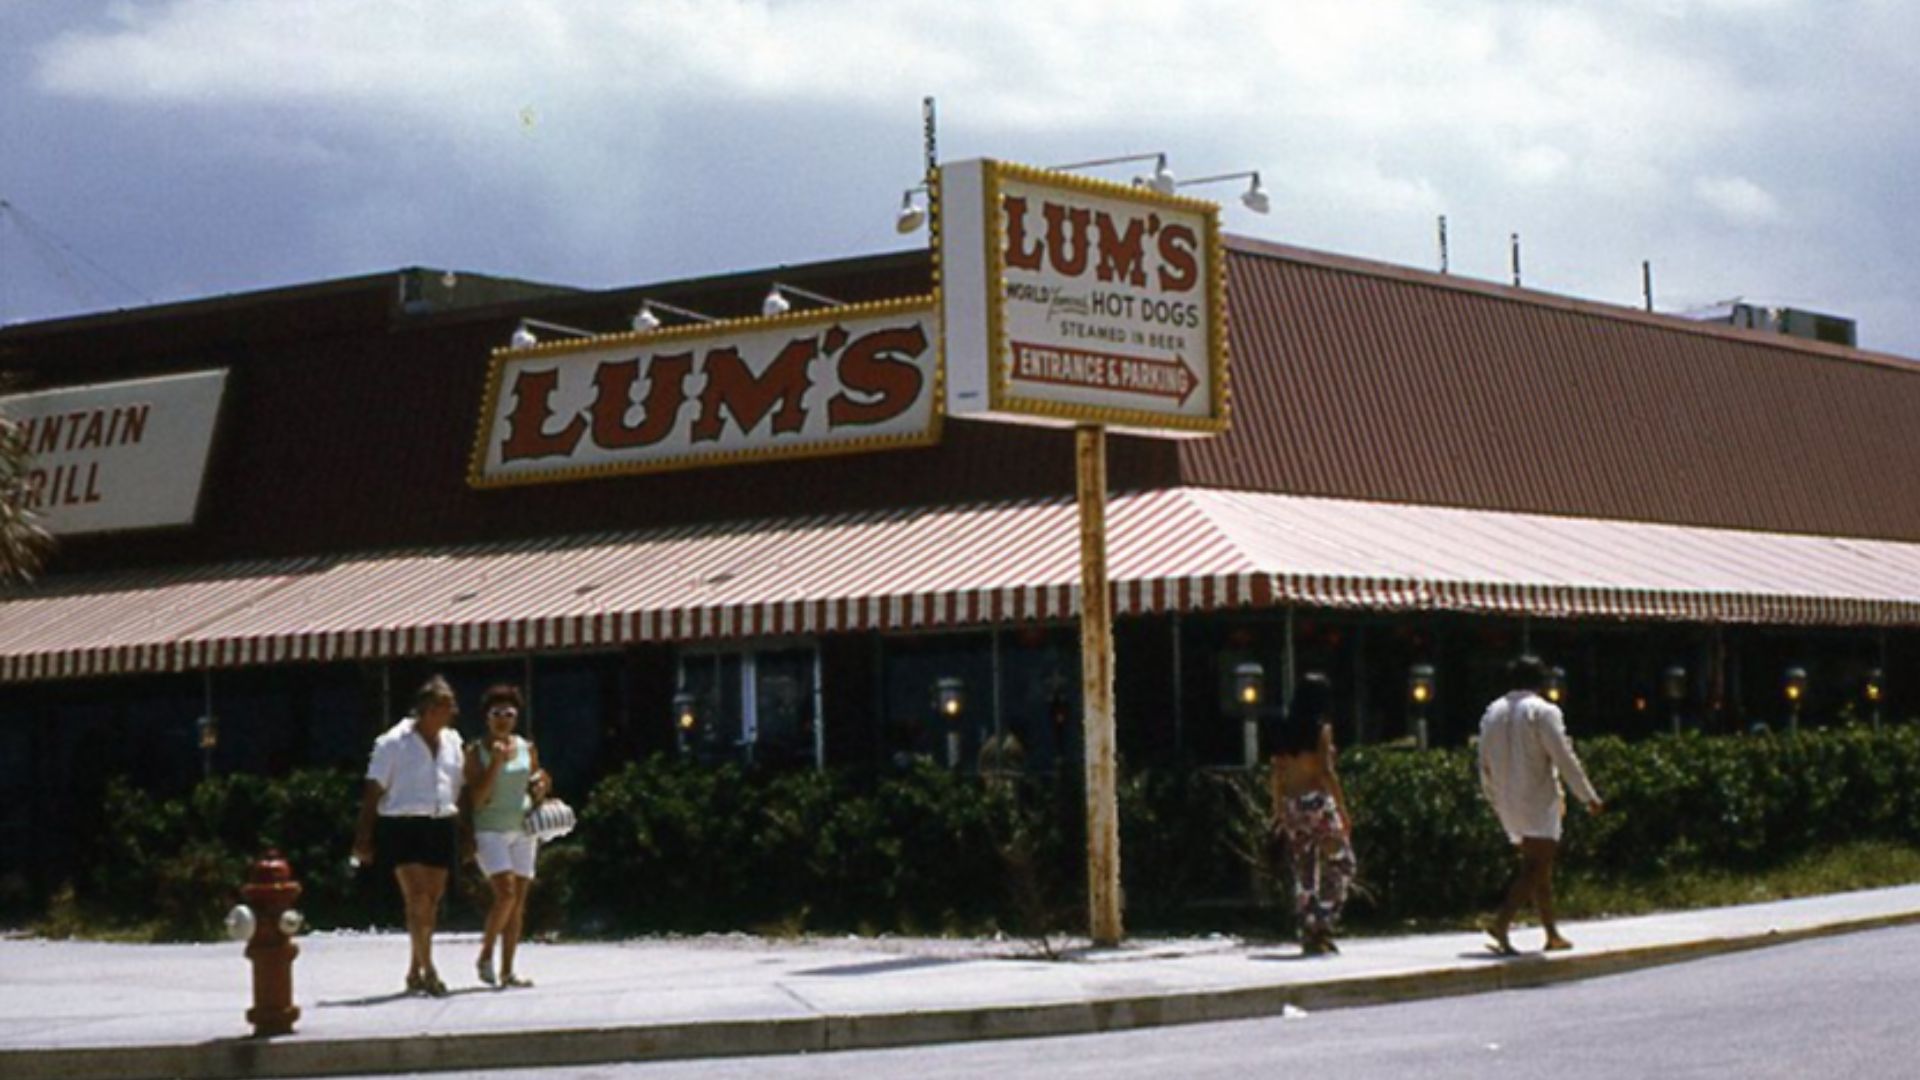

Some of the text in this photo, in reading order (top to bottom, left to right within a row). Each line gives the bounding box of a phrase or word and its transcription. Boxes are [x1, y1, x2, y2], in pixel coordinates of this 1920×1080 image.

[1002, 195, 1198, 292] LUM'S
[1091, 290, 1135, 320] HOT
[1141, 299, 1199, 328] DOGS
[1060, 320, 1127, 343] STEAMED
[1020, 347, 1105, 386] ENTRANCE
[501, 320, 929, 463] LUM'S
